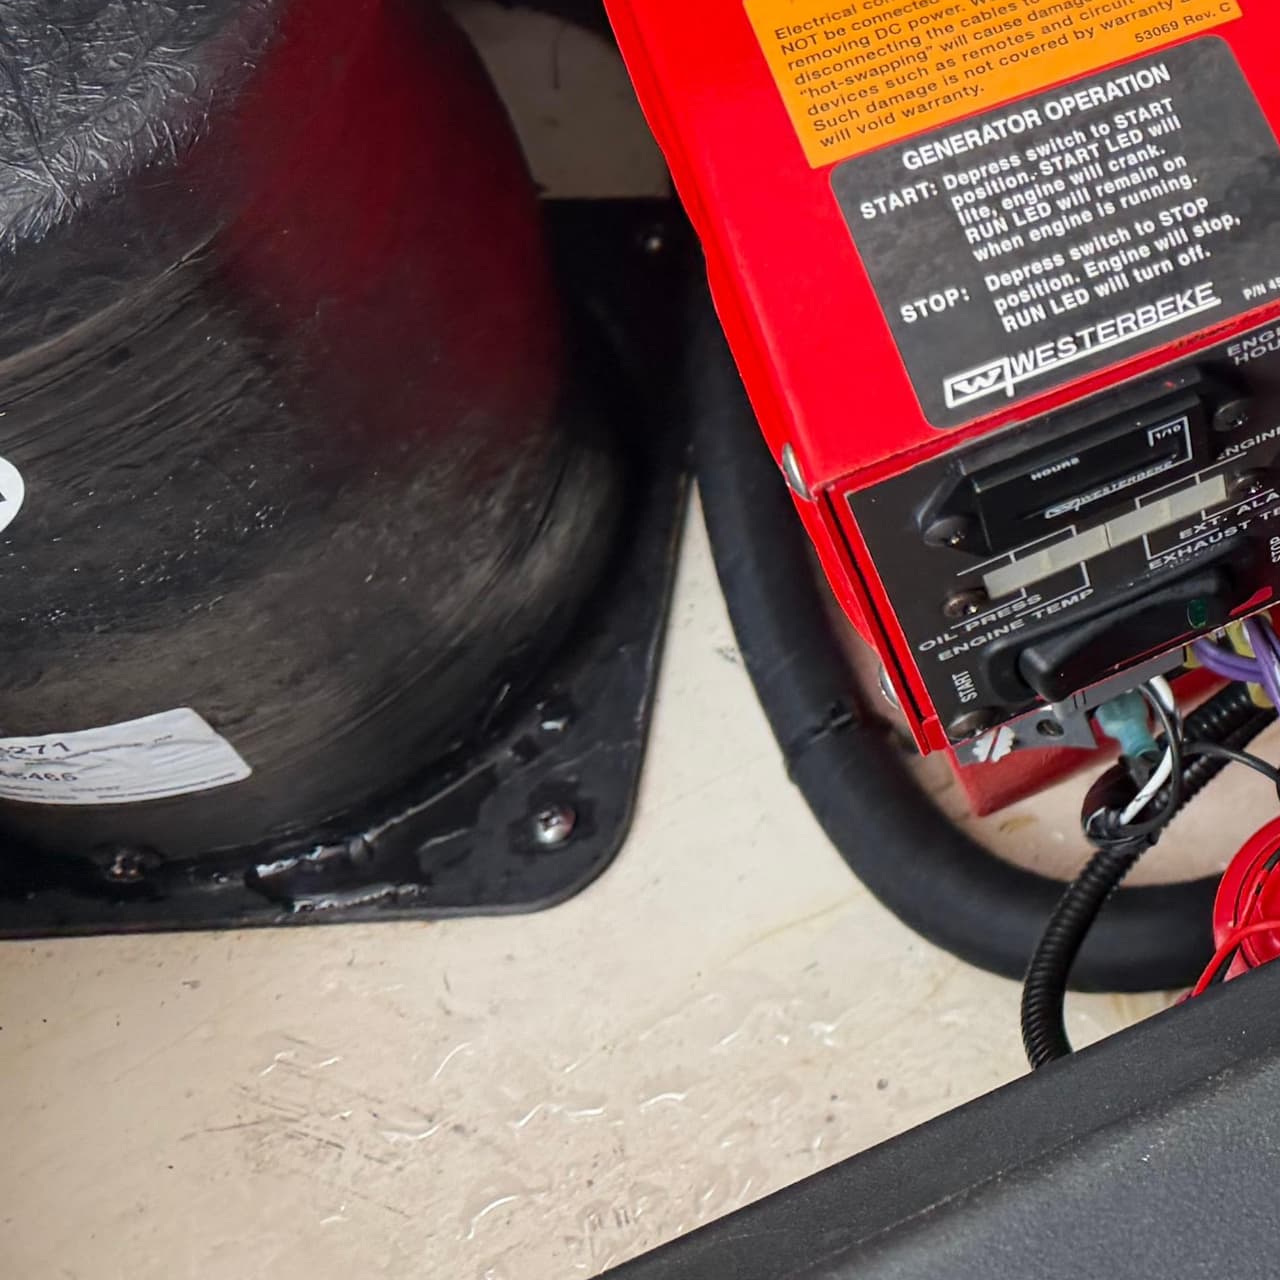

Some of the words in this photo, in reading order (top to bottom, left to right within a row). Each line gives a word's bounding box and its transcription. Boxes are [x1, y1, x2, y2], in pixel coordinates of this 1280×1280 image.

[773, 3, 857, 40] Electrical
[780, 32, 817, 56] NOT
[822, 26, 847, 41] be
[1134, 19, 1179, 43] 53069
[1182, 10, 1216, 26] Rev.
[1218, 1, 1231, 13] C
[901, 108, 1043, 170] GENERATOR
[1043, 63, 1171, 121] OPERATION
[859, 180, 938, 220] START:
[941, 154, 1022, 191] Depress
[1025, 129, 1087, 162] switch
[1089, 122, 1111, 138] to
[1113, 97, 1173, 130] START
[950, 171, 1038, 211] position.
[1038, 142, 1100, 176] START
[1104, 128, 1144, 153] LED
[1147, 114, 1181, 137] will
[983, 253, 1065, 292] Depress
[1068, 227, 1132, 261] switch
[1133, 219, 1155, 236] to
[1158, 196, 1209, 227] STOP
[899, 287, 970, 323] STOP:
[1242, 282, 1267, 300] P/N
[1005, 281, 1222, 380] WESTERBEKE
[1149, 520, 1251, 570] EXHAUST
[1179, 515, 1228, 541] EXT.
[919, 633, 959, 652] OIL
[965, 593, 1042, 632] PRESS
[937, 619, 1025, 662] ENGINE
[1032, 588, 1094, 620] TEMP
[952, 670, 978, 704] START
